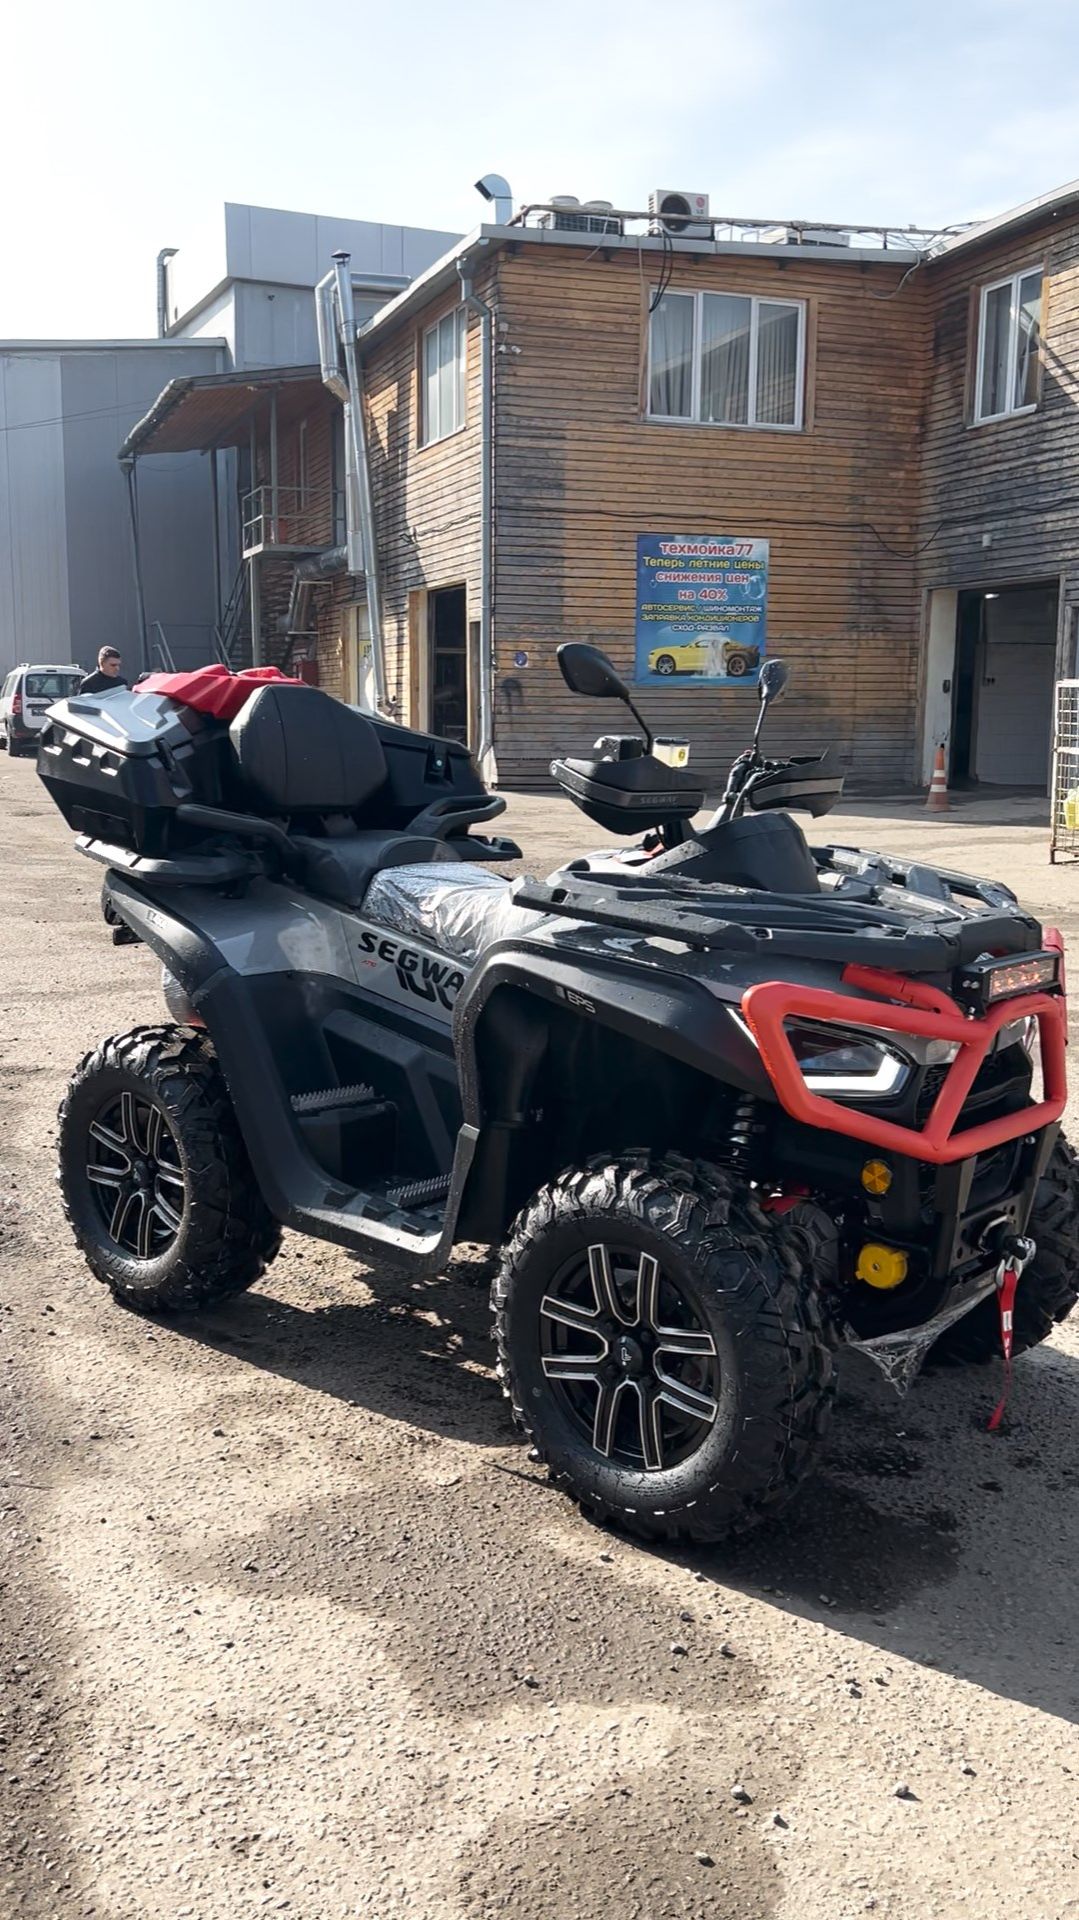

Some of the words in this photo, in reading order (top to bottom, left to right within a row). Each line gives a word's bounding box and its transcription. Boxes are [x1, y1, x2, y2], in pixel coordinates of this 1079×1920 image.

[660, 542, 753, 556] техмойка77
[643, 556, 685, 569] Теперь
[689, 559, 730, 569] летние
[734, 560, 765, 570] цены
[656, 572, 722, 583] снижения
[725, 573, 749, 584] цен
[678, 589, 696, 601] на
[698, 588, 728, 601] 40%
[703, 605, 761, 613] ШИНОМОНТАЖ
[566, 990, 596, 1014] EPS
